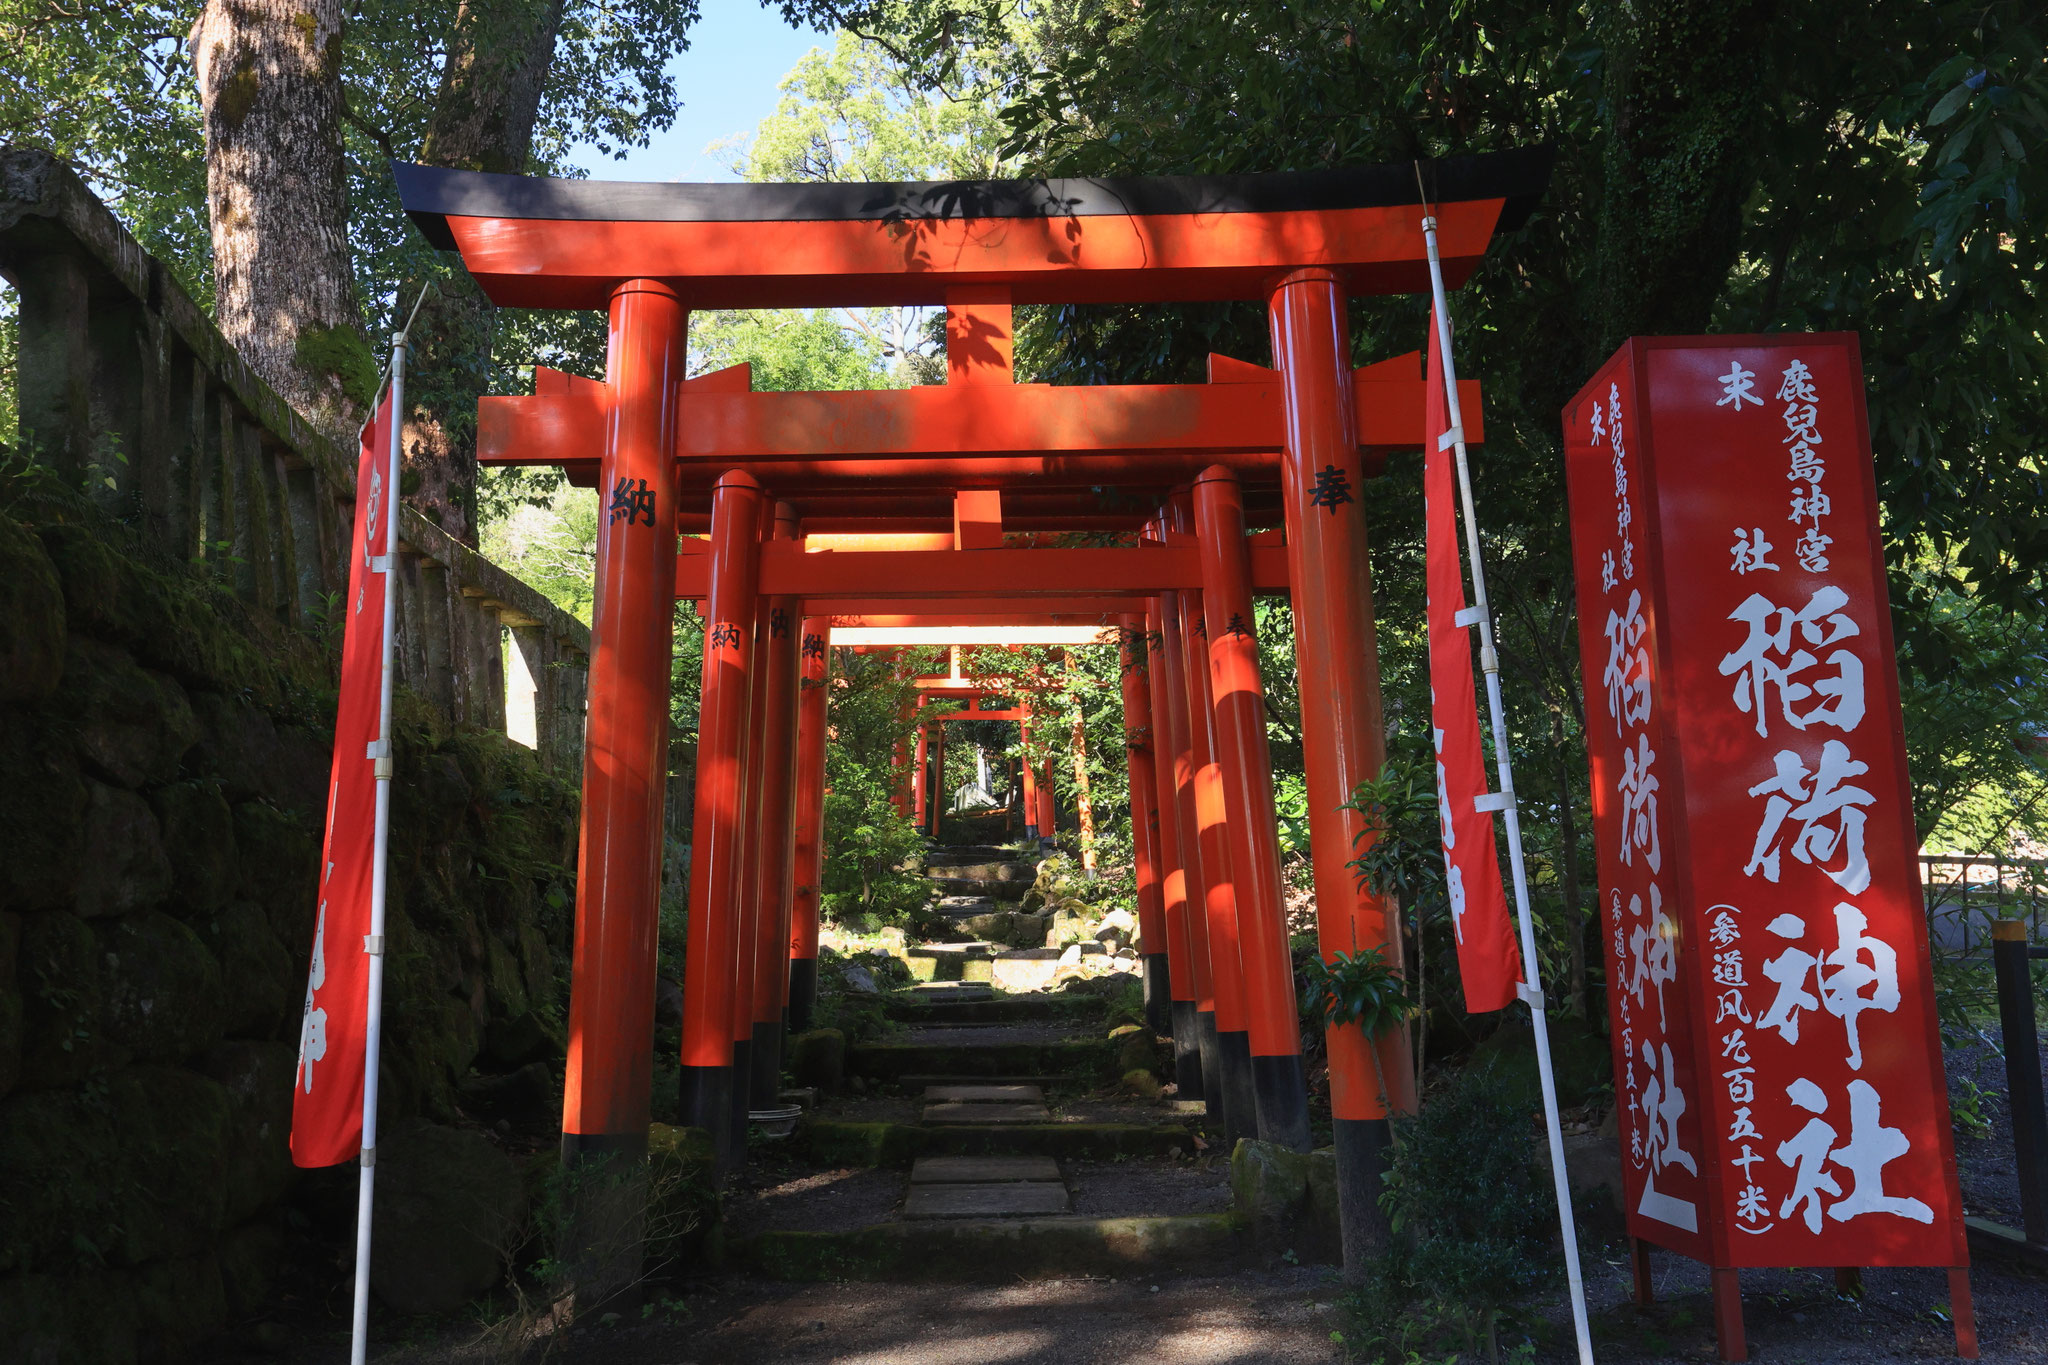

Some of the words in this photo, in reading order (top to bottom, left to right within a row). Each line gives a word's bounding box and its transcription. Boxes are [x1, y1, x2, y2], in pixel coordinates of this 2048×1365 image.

[609, 476, 656, 527] 納
[1307, 464, 1354, 516] 奉
[712, 624, 740, 650] 納
[1223, 613, 1253, 641] 奉
[802, 633, 826, 659] 納
